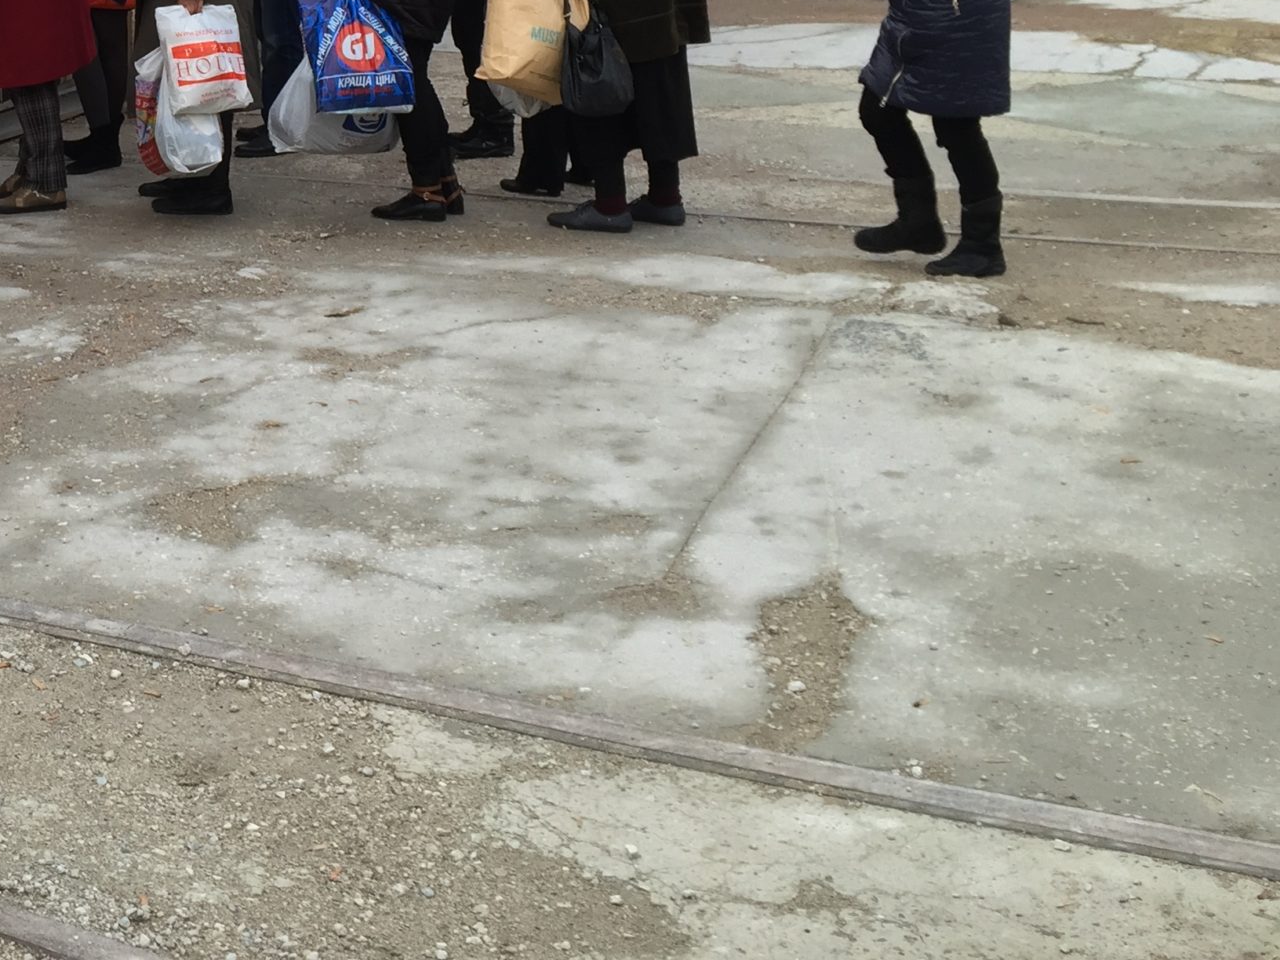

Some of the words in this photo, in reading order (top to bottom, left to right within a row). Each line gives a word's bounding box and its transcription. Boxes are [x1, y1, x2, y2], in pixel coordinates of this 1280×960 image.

[327, 6, 345, 33] МОДА
[341, 32, 376, 61] GJ
[338, 76, 373, 89] КРАЩА
[375, 74, 397, 87] ЦІНА
